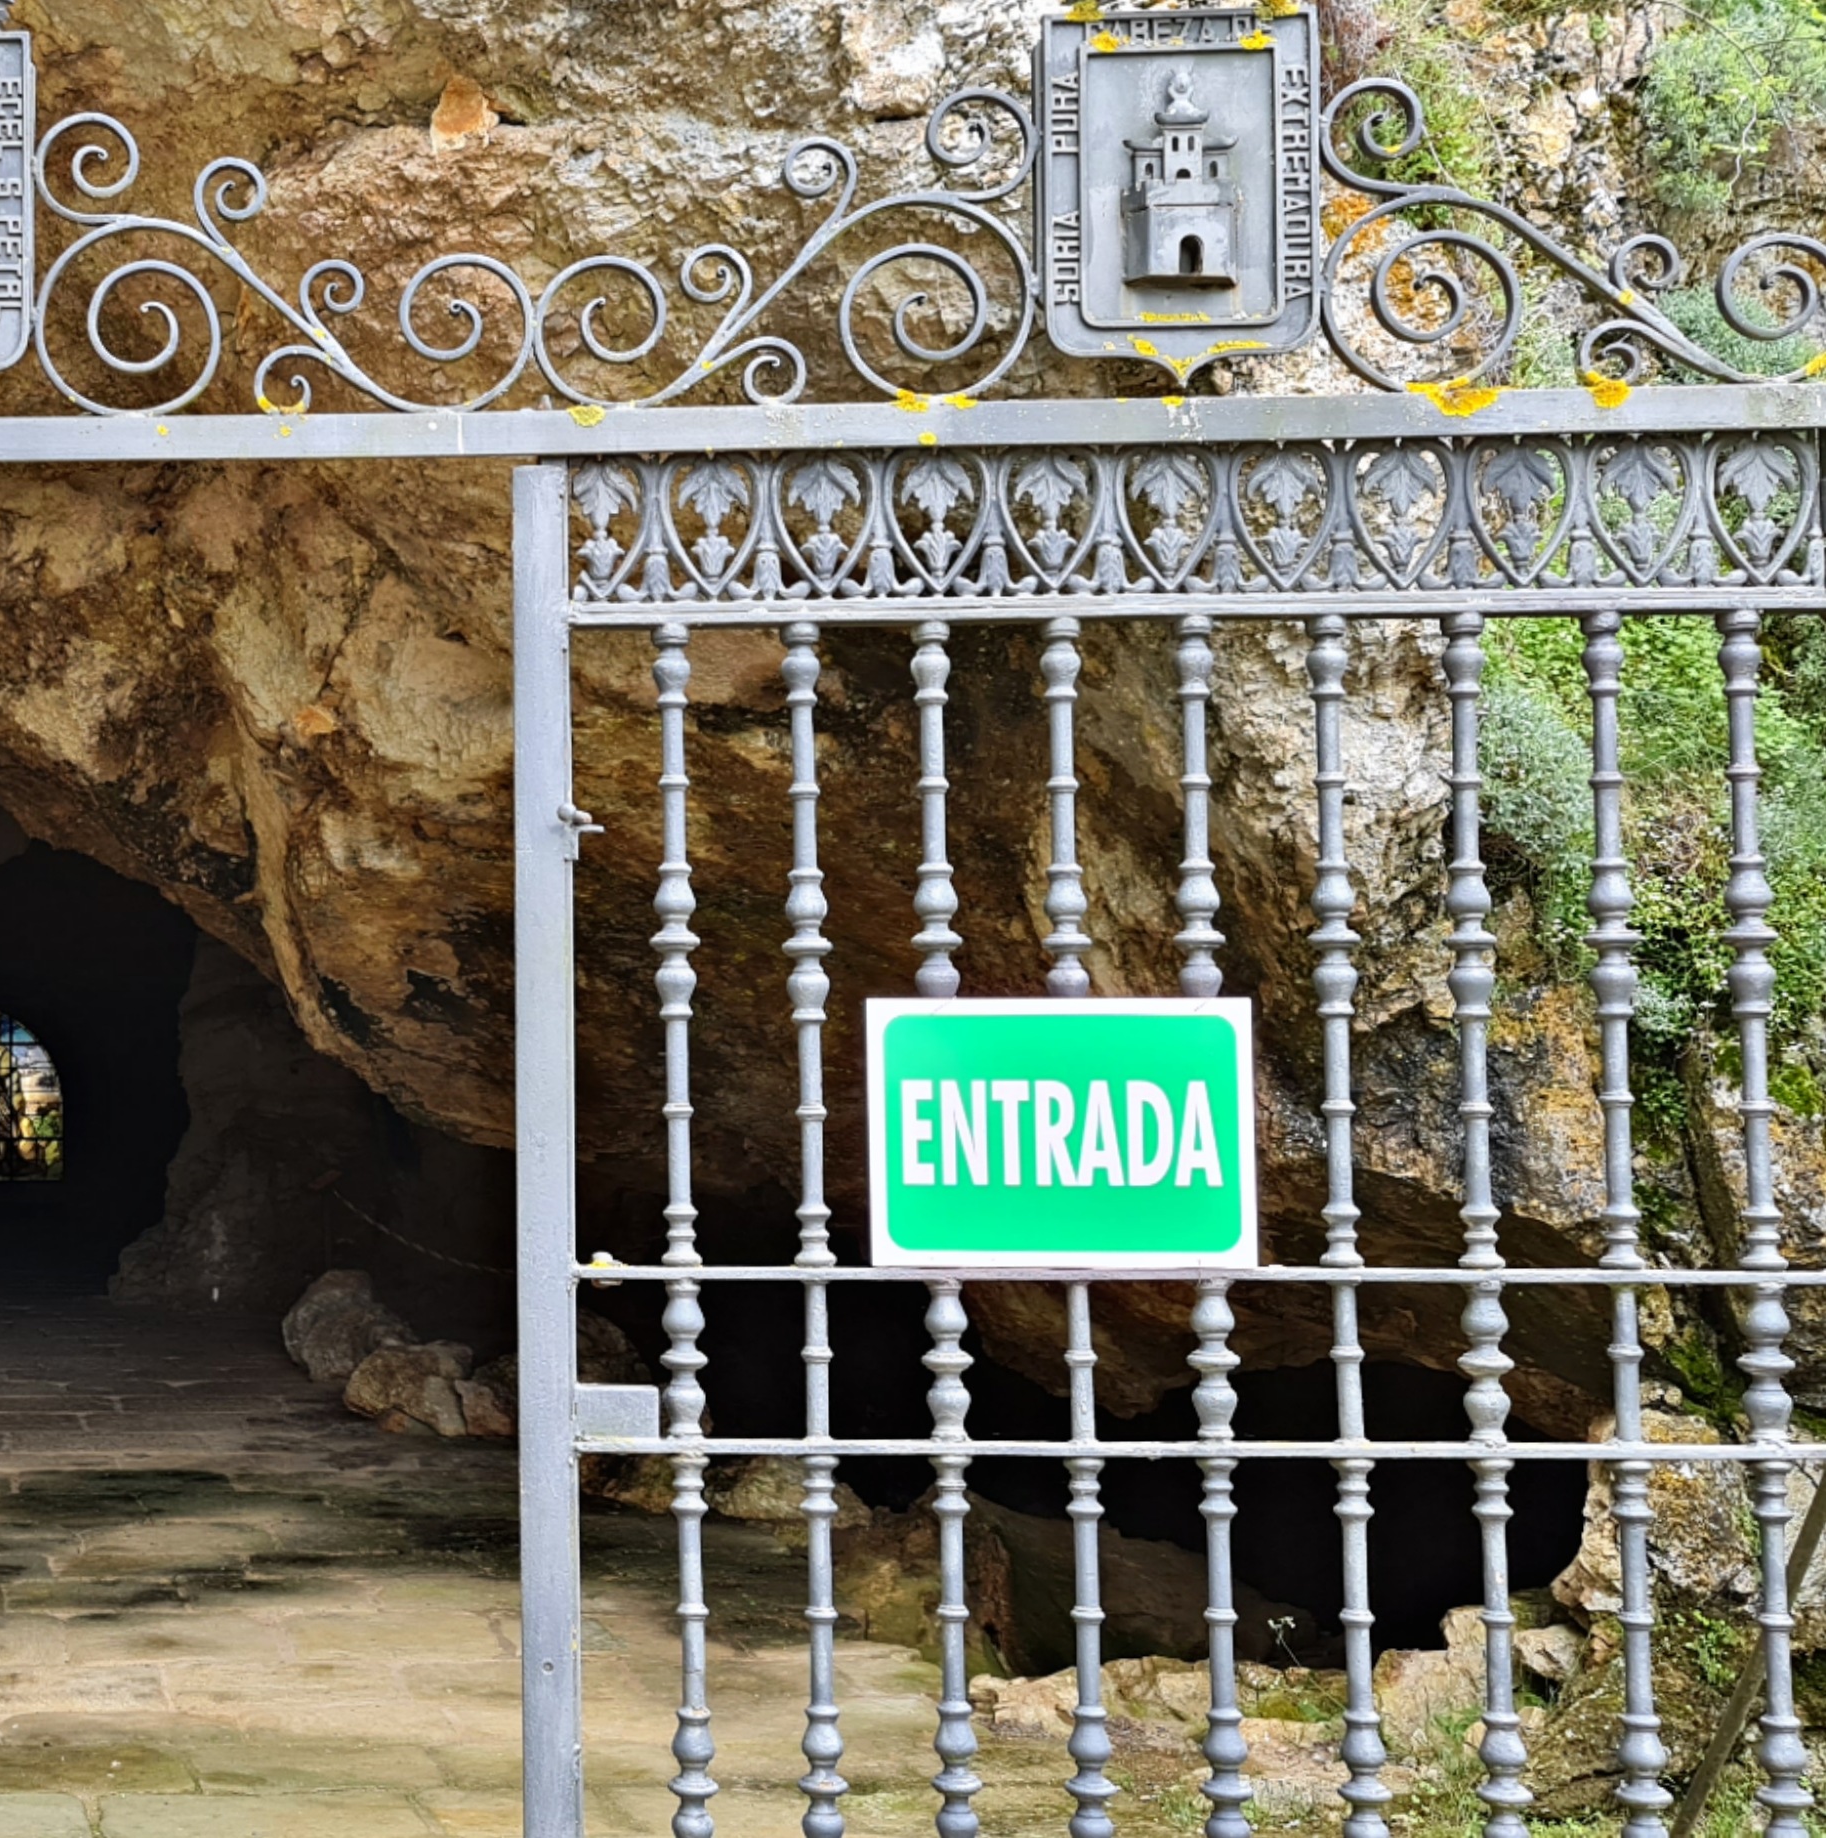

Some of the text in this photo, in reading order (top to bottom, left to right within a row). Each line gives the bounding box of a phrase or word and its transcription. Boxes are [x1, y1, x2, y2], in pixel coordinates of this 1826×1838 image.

[1051, 71, 1081, 306] SORIA PURA
[1280, 64, 1310, 302] EXTREMADURA
[900, 1079, 1224, 1188] ENTRADA
